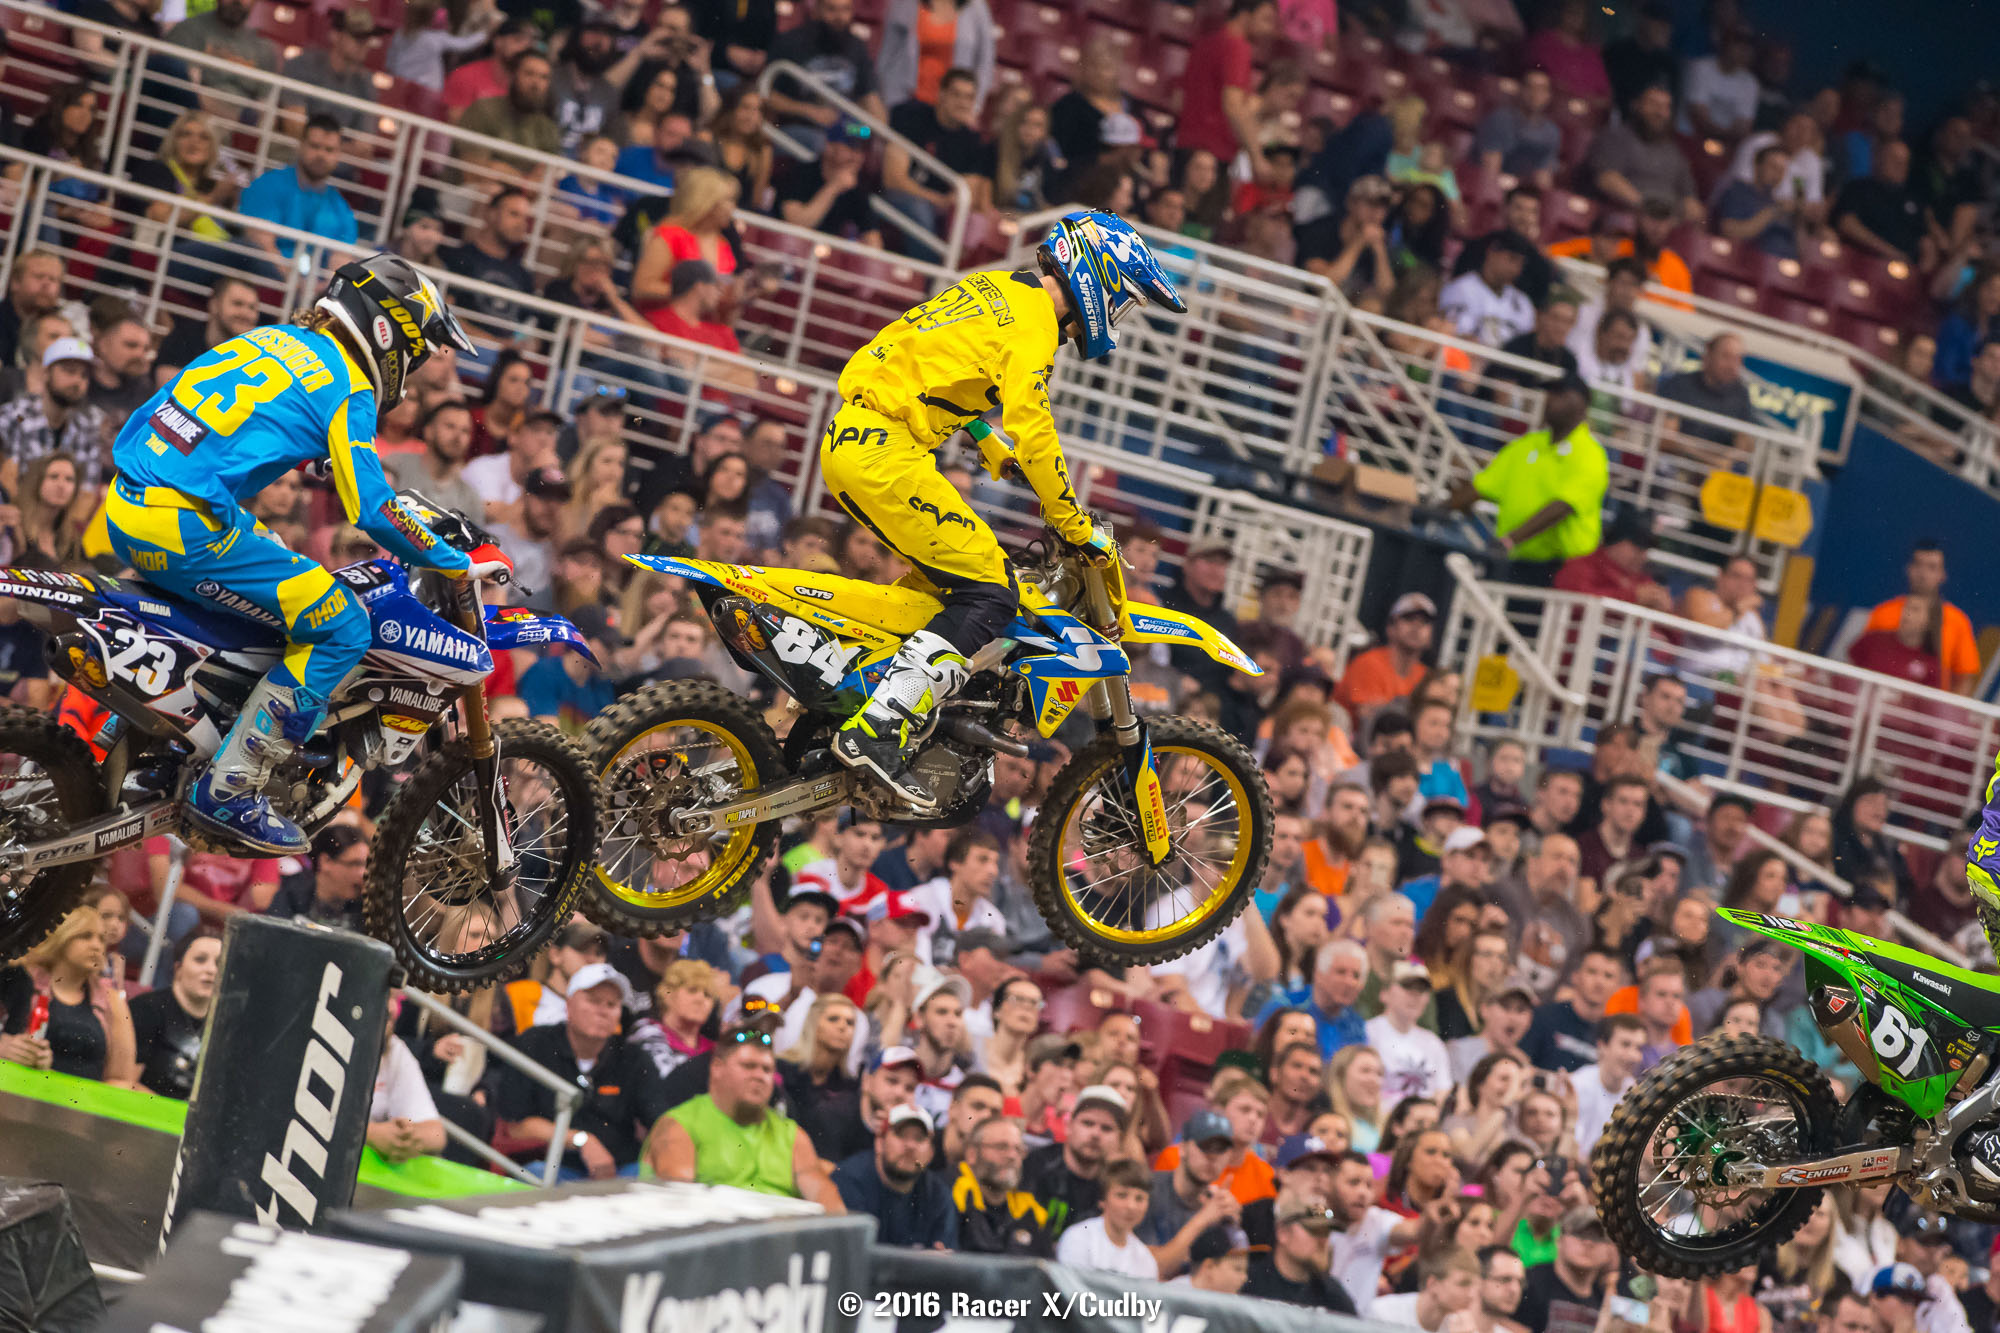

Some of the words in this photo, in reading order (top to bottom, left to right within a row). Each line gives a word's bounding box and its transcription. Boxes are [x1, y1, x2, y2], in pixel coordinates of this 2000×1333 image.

[1059, 239, 1070, 262] BELL
[377, 320, 390, 345] BELL
[379, 295, 426, 358] 100%
[171, 337, 294, 438] 23
[154, 400, 203, 444] YAMALUBE
[340, 569, 371, 585] 23
[724, 577, 767, 603] PIRELLI
[0, 583, 84, 604] DUNLOP
[795, 586, 833, 600] GUTS
[138, 600, 171, 617] YAMAHA
[214, 589, 284, 627] YAMAHA
[303, 587, 349, 630] THOR
[863, 633, 885, 645] EVS
[1134, 617, 1192, 638] SUPERSTORE!
[404, 625, 479, 665] YAMAHA
[770, 615, 861, 687] 84
[109, 628, 178, 696] 23
[388, 686, 445, 713] YAMALUBE
[1148, 781, 1167, 841] PIRELLI
[98, 821, 143, 847] YAMALUBE
[32, 841, 90, 863] GYTR
[713, 845, 760, 900] PIRELLI
[553, 860, 588, 926] DUNLOP
[1912, 970, 1954, 997] Kawasaki
[1870, 1004, 1929, 1078] 61
[1777, 1164, 1850, 1185] RENTHAL
[619, 1249, 831, 1333] Kawasaki
